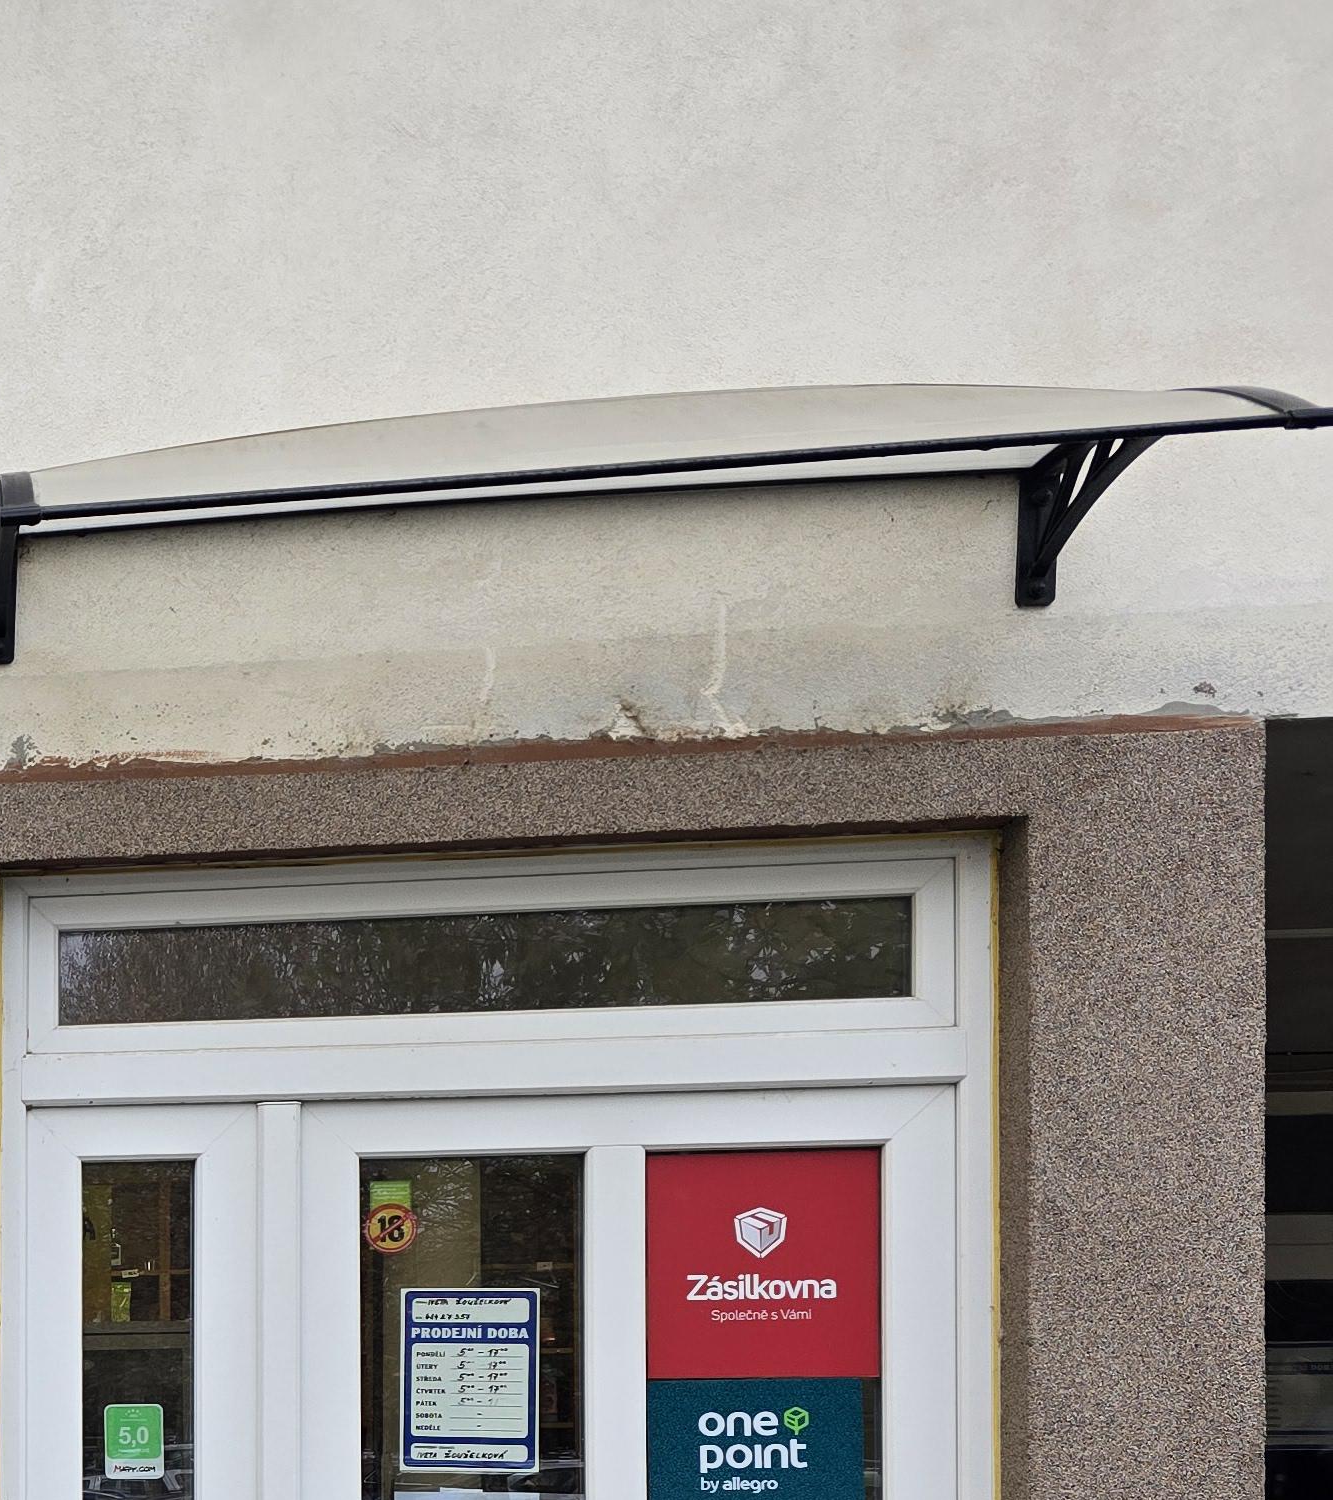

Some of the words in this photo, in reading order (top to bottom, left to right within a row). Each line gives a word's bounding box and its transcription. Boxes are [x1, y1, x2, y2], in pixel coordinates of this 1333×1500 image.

[377, 1215, 405, 1243] 18
[686, 1274, 838, 1301] Zásilkovna
[711, 1308, 769, 1323] Společně
[771, 1311, 778, 1321] s
[780, 1308, 812, 1321] Vámi
[411, 1325, 482, 1339] PRODEJNÍ
[488, 1328, 529, 1339] DOBA
[698, 1411, 779, 1437] one
[118, 1426, 150, 1448] 5,0
[699, 1438, 808, 1473] point
[700, 1477, 720, 1493] by
[722, 1477, 779, 1493] allegro
